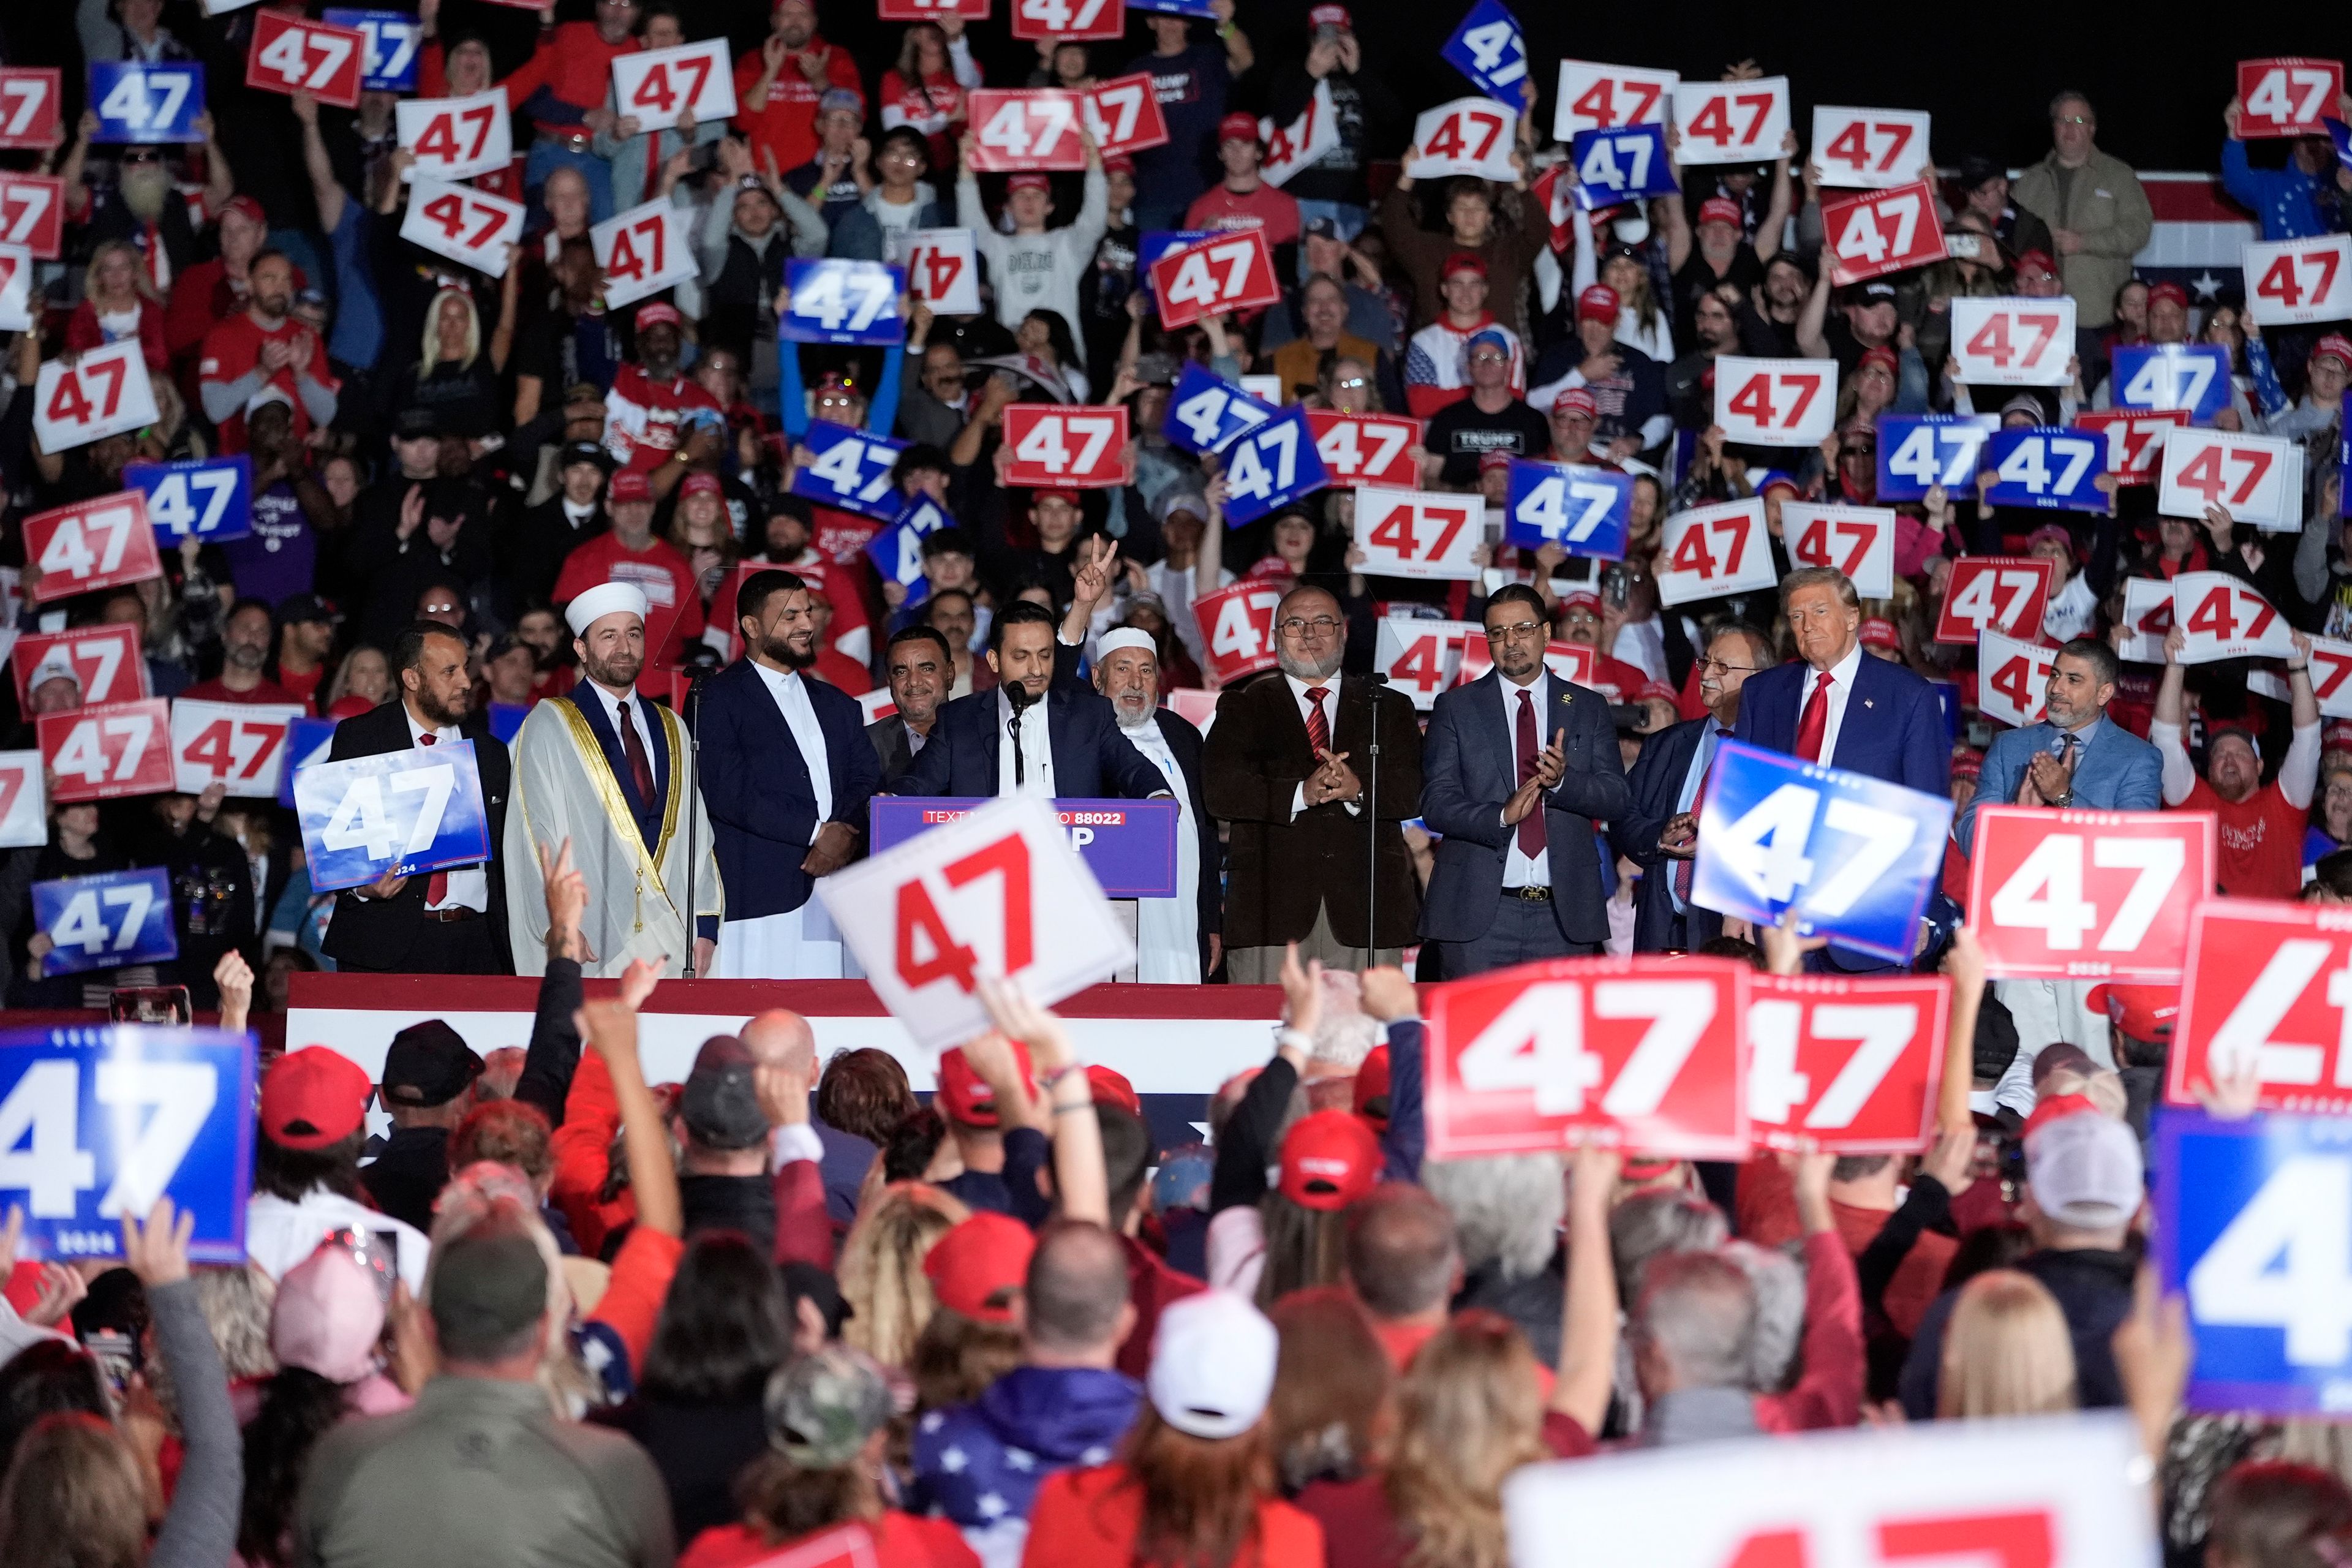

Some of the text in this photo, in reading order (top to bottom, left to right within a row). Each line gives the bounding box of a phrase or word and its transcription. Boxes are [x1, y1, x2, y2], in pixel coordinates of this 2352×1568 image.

[260, 28, 352, 89] 47
[633, 56, 713, 113] 47
[0, 80, 47, 135] 7
[100, 72, 191, 129] 47
[1572, 78, 1662, 127] 47
[1688, 94, 1773, 146] 47
[2246, 69, 2333, 124] 47
[416, 105, 494, 164] 47
[981, 100, 1076, 156] 47
[1425, 111, 1503, 160] 47
[1826, 122, 1913, 172] 47
[1580, 134, 1654, 191] 47
[0, 187, 51, 243] 7
[424, 194, 509, 249] 47
[1836, 193, 1921, 263] 47
[608, 215, 665, 281] 47
[1167, 239, 1256, 306] 47
[794, 268, 894, 331] 47
[2257, 251, 2340, 307] 47
[1966, 314, 2060, 368] 47
[47, 358, 127, 425] 47
[1729, 373, 1821, 429] 47
[2124, 356, 2216, 419] 47
[1016, 417, 1115, 475] 47
[1176, 386, 1270, 454] 47
[1317, 421, 1408, 477] 47
[810, 439, 899, 503] 47
[1227, 418, 1299, 500] 47
[1889, 426, 1989, 486] 47
[1998, 437, 2095, 496] 47
[2177, 446, 2273, 506] 47
[147, 467, 238, 535] 47
[1516, 477, 1618, 543] 47
[38, 507, 133, 578] 47
[1370, 505, 1466, 562] 47
[1672, 516, 1751, 579] 47
[1796, 519, 1877, 567] 47
[1951, 569, 2040, 631] 47
[2187, 586, 2277, 641] 47
[51, 716, 153, 784] 47
[184, 720, 285, 778] 47
[321, 763, 456, 861] 47
[927, 811, 965, 823] TEXT
[1074, 813, 1120, 824] 88022
[1715, 782, 1918, 918] 47
[51, 883, 153, 954] 47
[895, 831, 1033, 995] 47
[1990, 834, 2185, 951] 47
[1457, 981, 1716, 1117] 47
[0, 1058, 218, 1219] 47
